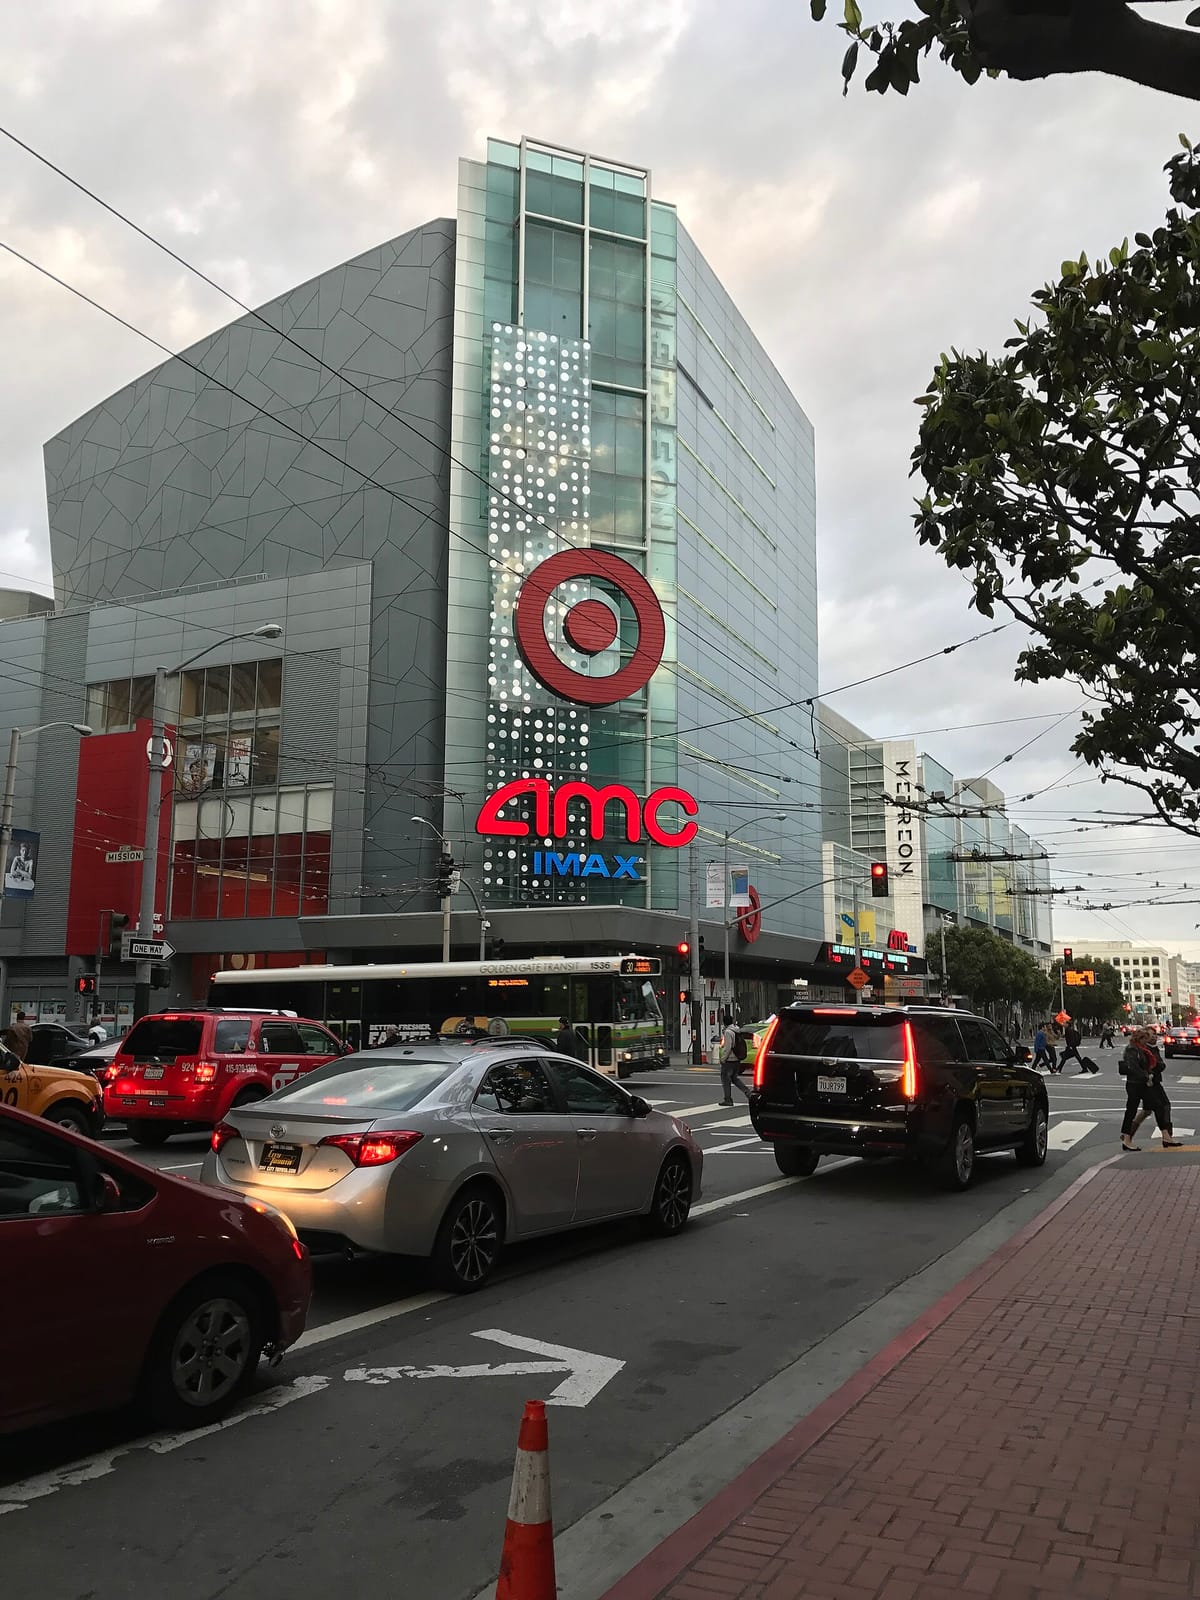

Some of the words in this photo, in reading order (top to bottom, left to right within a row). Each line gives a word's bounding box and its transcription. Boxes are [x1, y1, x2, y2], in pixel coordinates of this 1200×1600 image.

[896, 761, 913, 873] METREON
[108, 851, 141, 861] MISSION
[533, 851, 641, 879] IMAX
[134, 944, 148, 953] ONE
[149, 945, 163, 954] WAY
[480, 964, 518, 975] GOLDEN
[518, 963, 542, 973] GATE
[543, 961, 579, 972] TRANSIT
[590, 961, 610, 970] 1536
[626, 961, 634, 973] 30
[181, 1062, 195, 1072] 924
